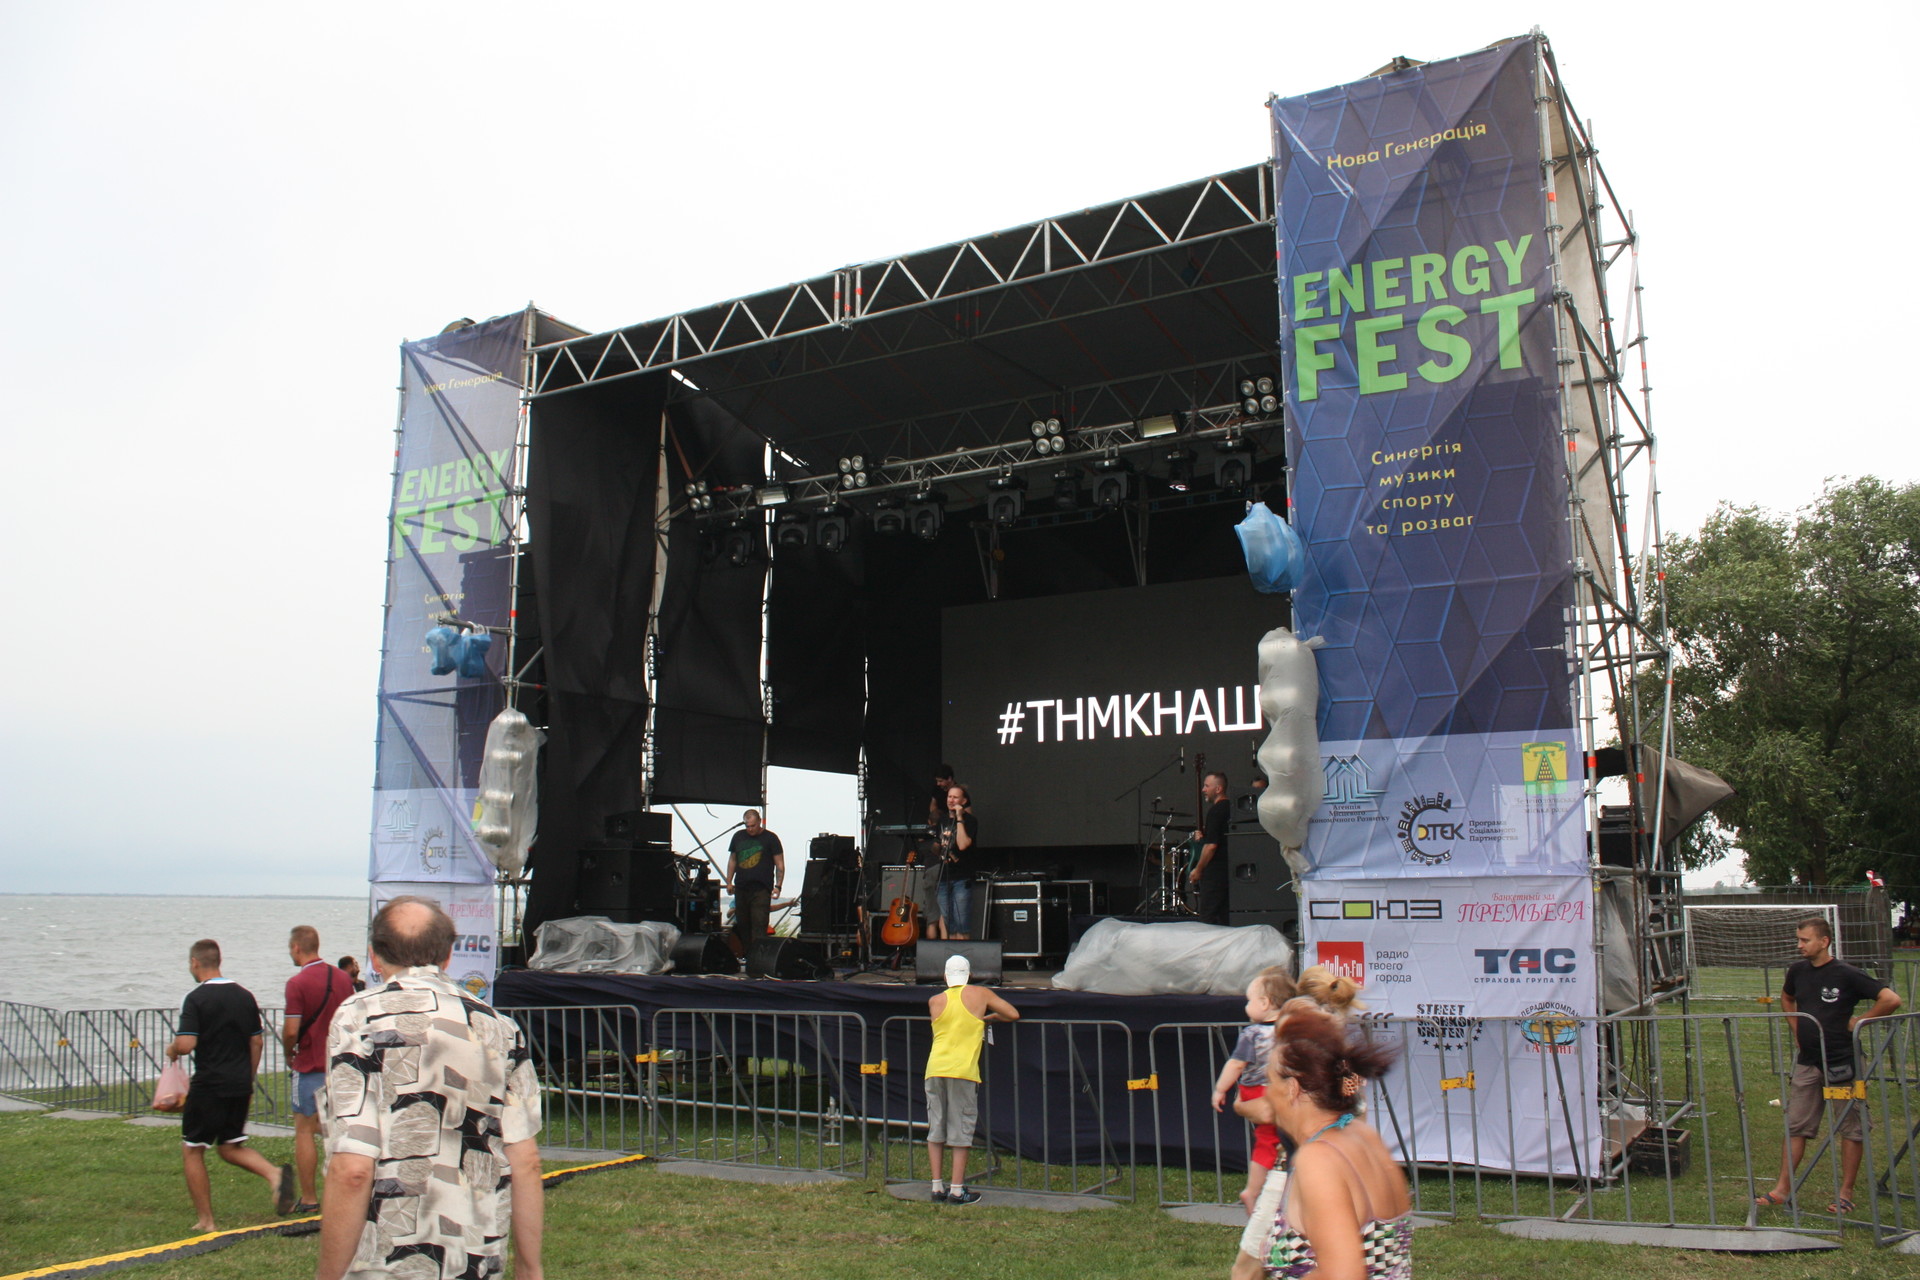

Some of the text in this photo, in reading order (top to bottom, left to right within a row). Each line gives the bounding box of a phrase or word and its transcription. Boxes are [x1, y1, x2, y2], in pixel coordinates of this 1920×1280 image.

[1326, 120, 1487, 170] Нова Генерація
[1293, 234, 1534, 322] ENERGY
[1295, 287, 1536, 402] FEST
[1371, 439, 1463, 466] Синергія
[399, 448, 510, 502] ENERGY
[1379, 467, 1456, 488] музики
[1382, 492, 1455, 510] спорту
[394, 489, 507, 559] FEST
[1366, 515, 1475, 537] та розваг
[1469, 820, 1507, 828] Програма
[1469, 827, 1516, 835] Соціального
[1469, 835, 1519, 843] Партнерства
[1309, 900, 1443, 920] СОЮЗ
[1457, 900, 1585, 923] ПРЕМЬЕРА
[1376, 950, 1409, 960] радио
[1368, 962, 1403, 970] твоего
[1375, 974, 1412, 984] города
[1416, 1003, 1465, 1016] STREET
